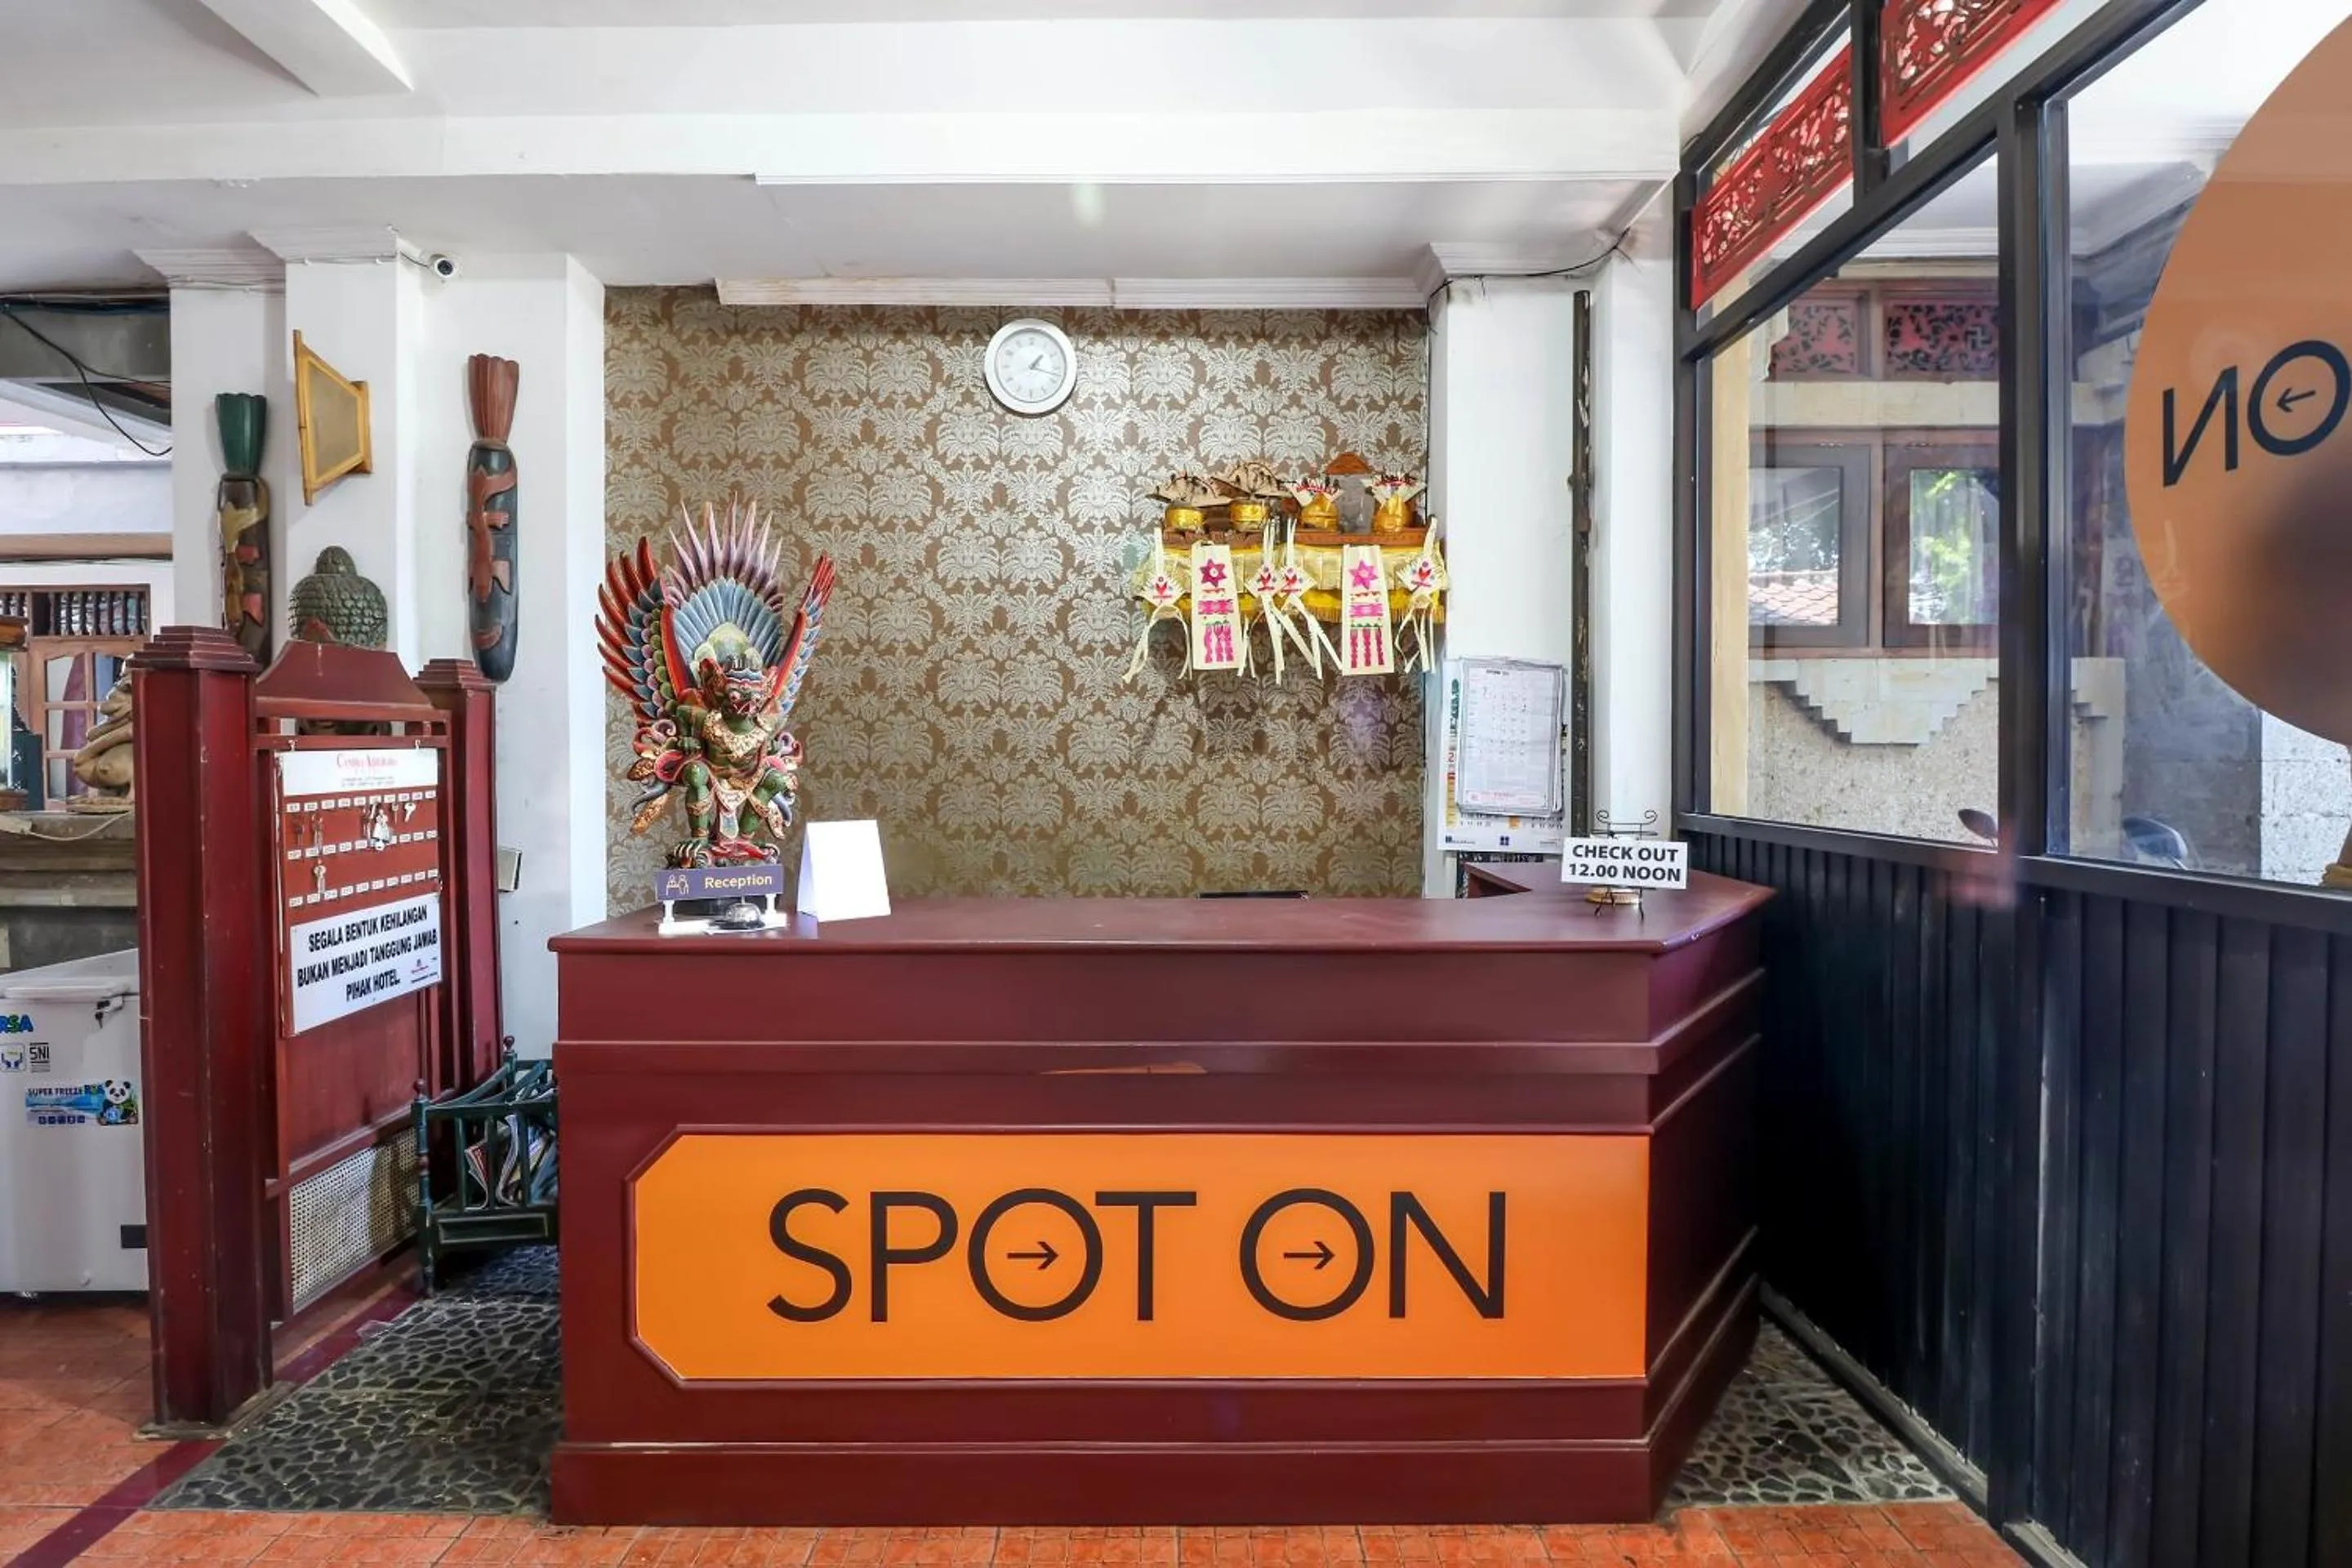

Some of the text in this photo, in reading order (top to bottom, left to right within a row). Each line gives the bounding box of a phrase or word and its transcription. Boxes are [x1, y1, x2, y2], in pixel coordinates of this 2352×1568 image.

[1572, 844, 1679, 862] CHECK OUT
[705, 874, 773, 889] Reception
[1569, 863, 1681, 882] 12.00 NOON
[309, 905, 428, 952] SEGALA BENTUK KEHILANGAN
[297, 929, 438, 988] BUKAN MENJADI TANGGUNG JAWAB
[346, 976, 372, 1001] PIHAK
[29, 1046, 49, 1060] SNI
[767, 1188, 1506, 1322] SPOT ON
